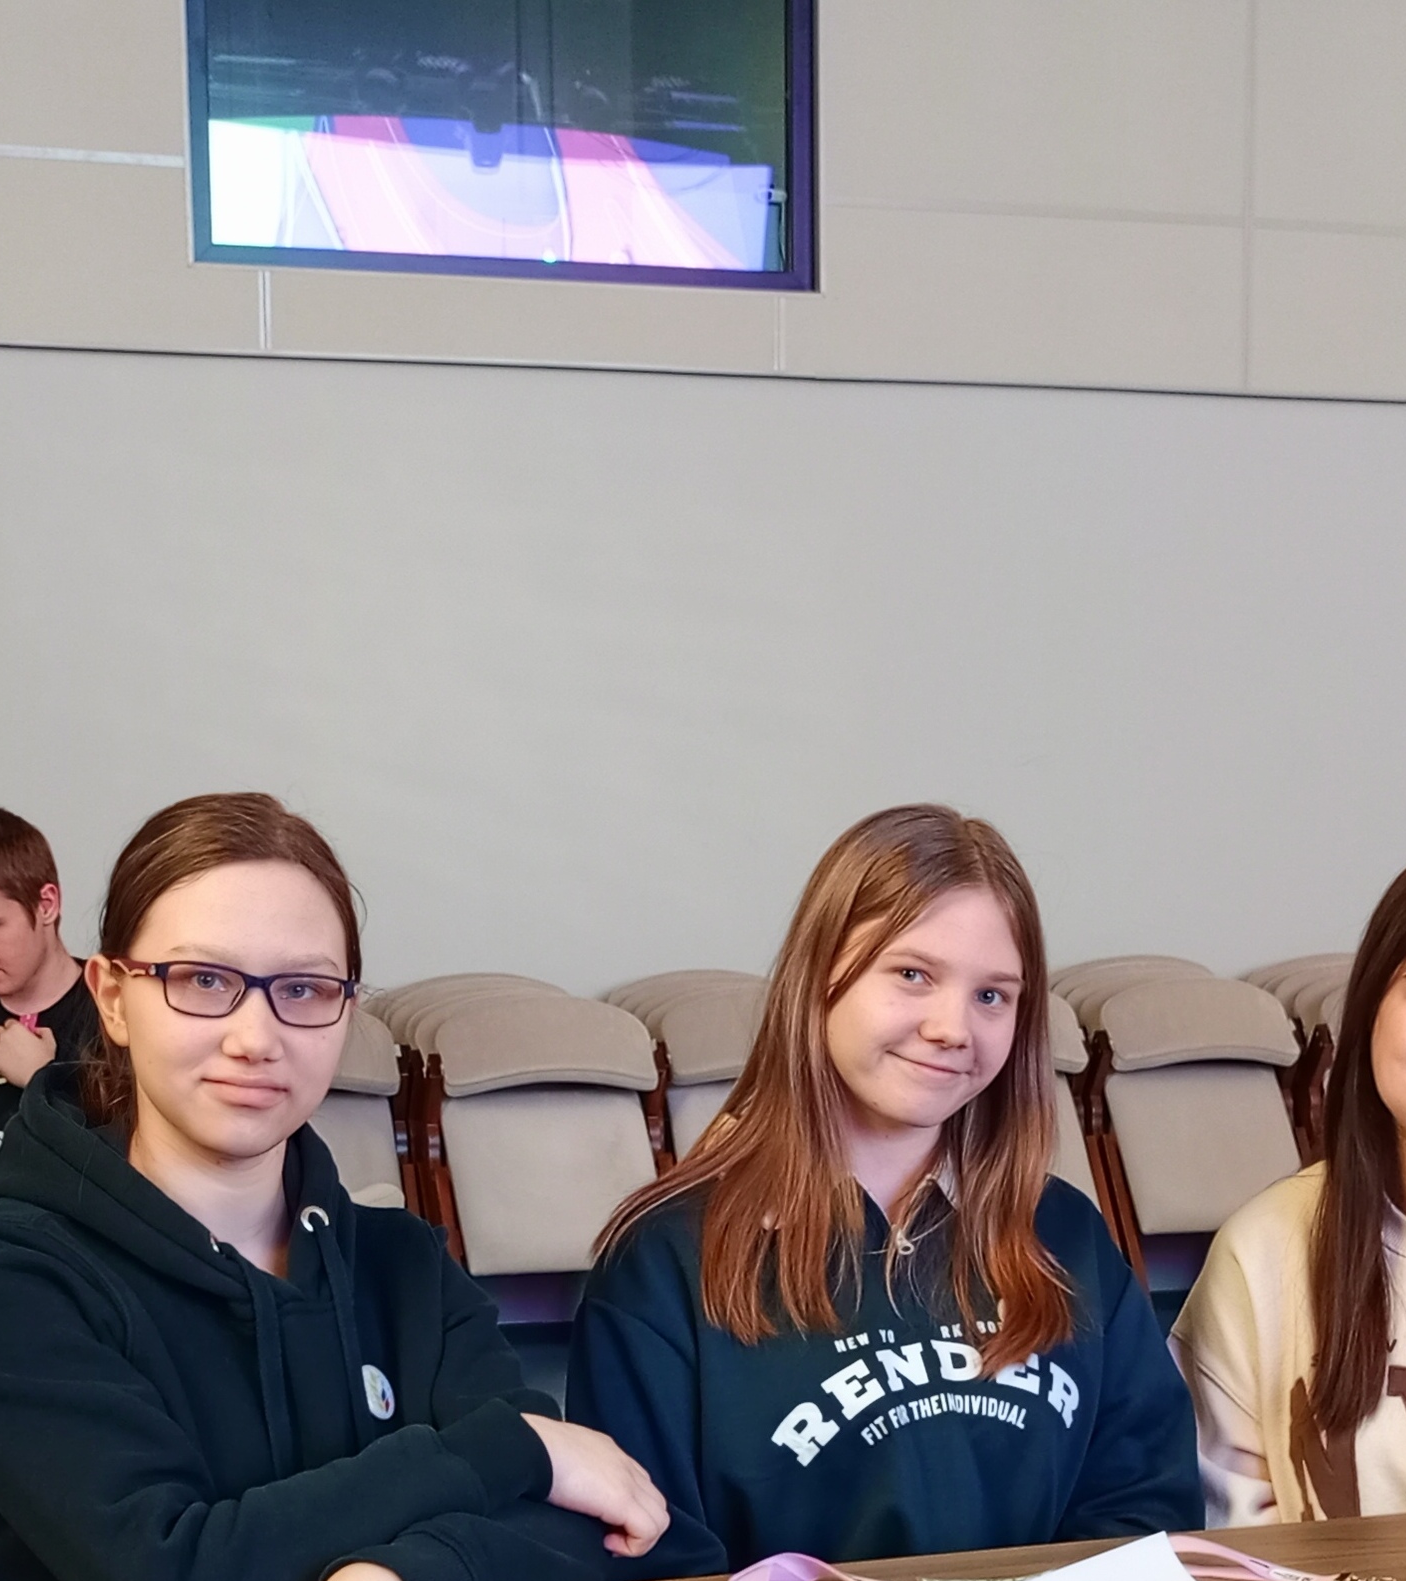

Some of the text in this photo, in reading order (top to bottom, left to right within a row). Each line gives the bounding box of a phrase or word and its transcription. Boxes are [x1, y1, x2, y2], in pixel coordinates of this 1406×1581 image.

[834, 1332, 870, 1353] NEW
[771, 1339, 1080, 1467] RENDER
[860, 1415, 889, 1446] FIT
